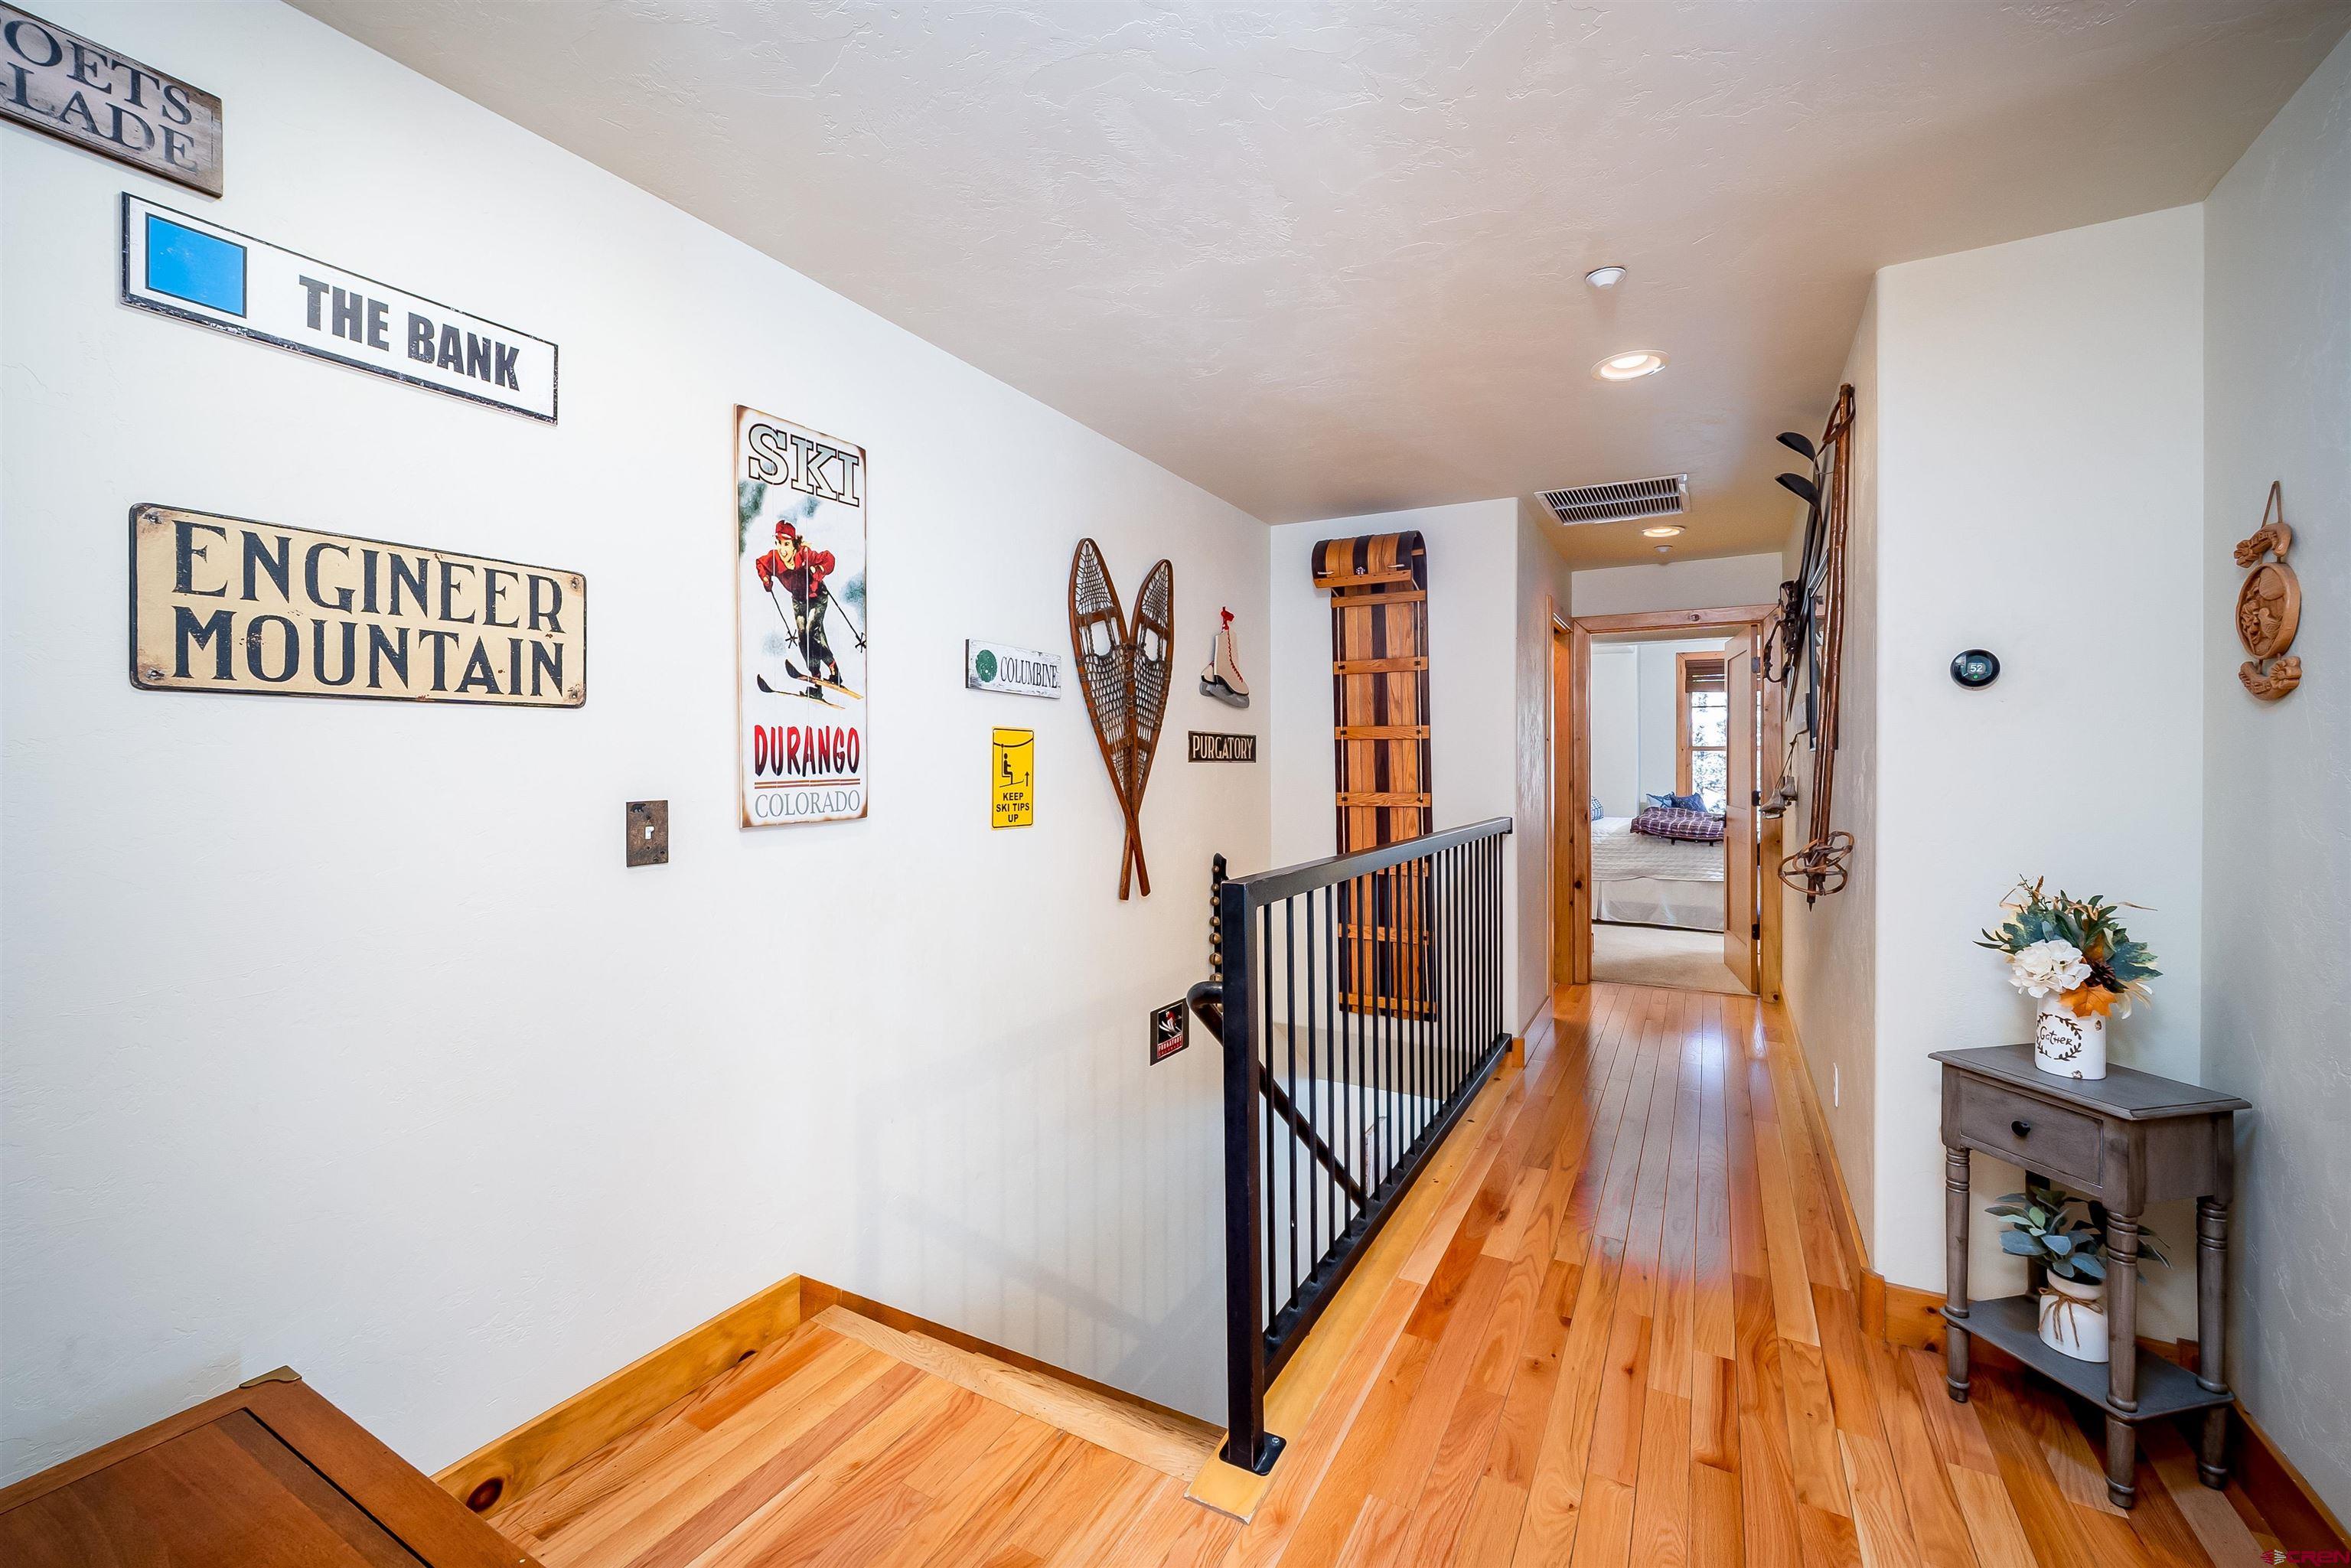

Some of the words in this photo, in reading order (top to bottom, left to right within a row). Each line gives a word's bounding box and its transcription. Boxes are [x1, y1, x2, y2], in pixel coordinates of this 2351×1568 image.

[0, 17, 194, 126] OETS
[0, 62, 198, 173] LADE
[298, 274, 390, 351] THE
[407, 311, 520, 392] BANK
[748, 423, 859, 507] SKI
[171, 520, 566, 634] ENGINEER
[171, 605, 564, 696] MOUNTAIN
[1000, 656, 1057, 688] COLUMBINE
[754, 724, 860, 777] DURANGO
[1192, 735, 1254, 759] PURGATORY
[755, 790, 860, 818] COLORADO
[996, 804, 1010, 812] SKI
[1012, 803, 1030, 811] TIPS
[1003, 792, 1024, 800] KEEP
